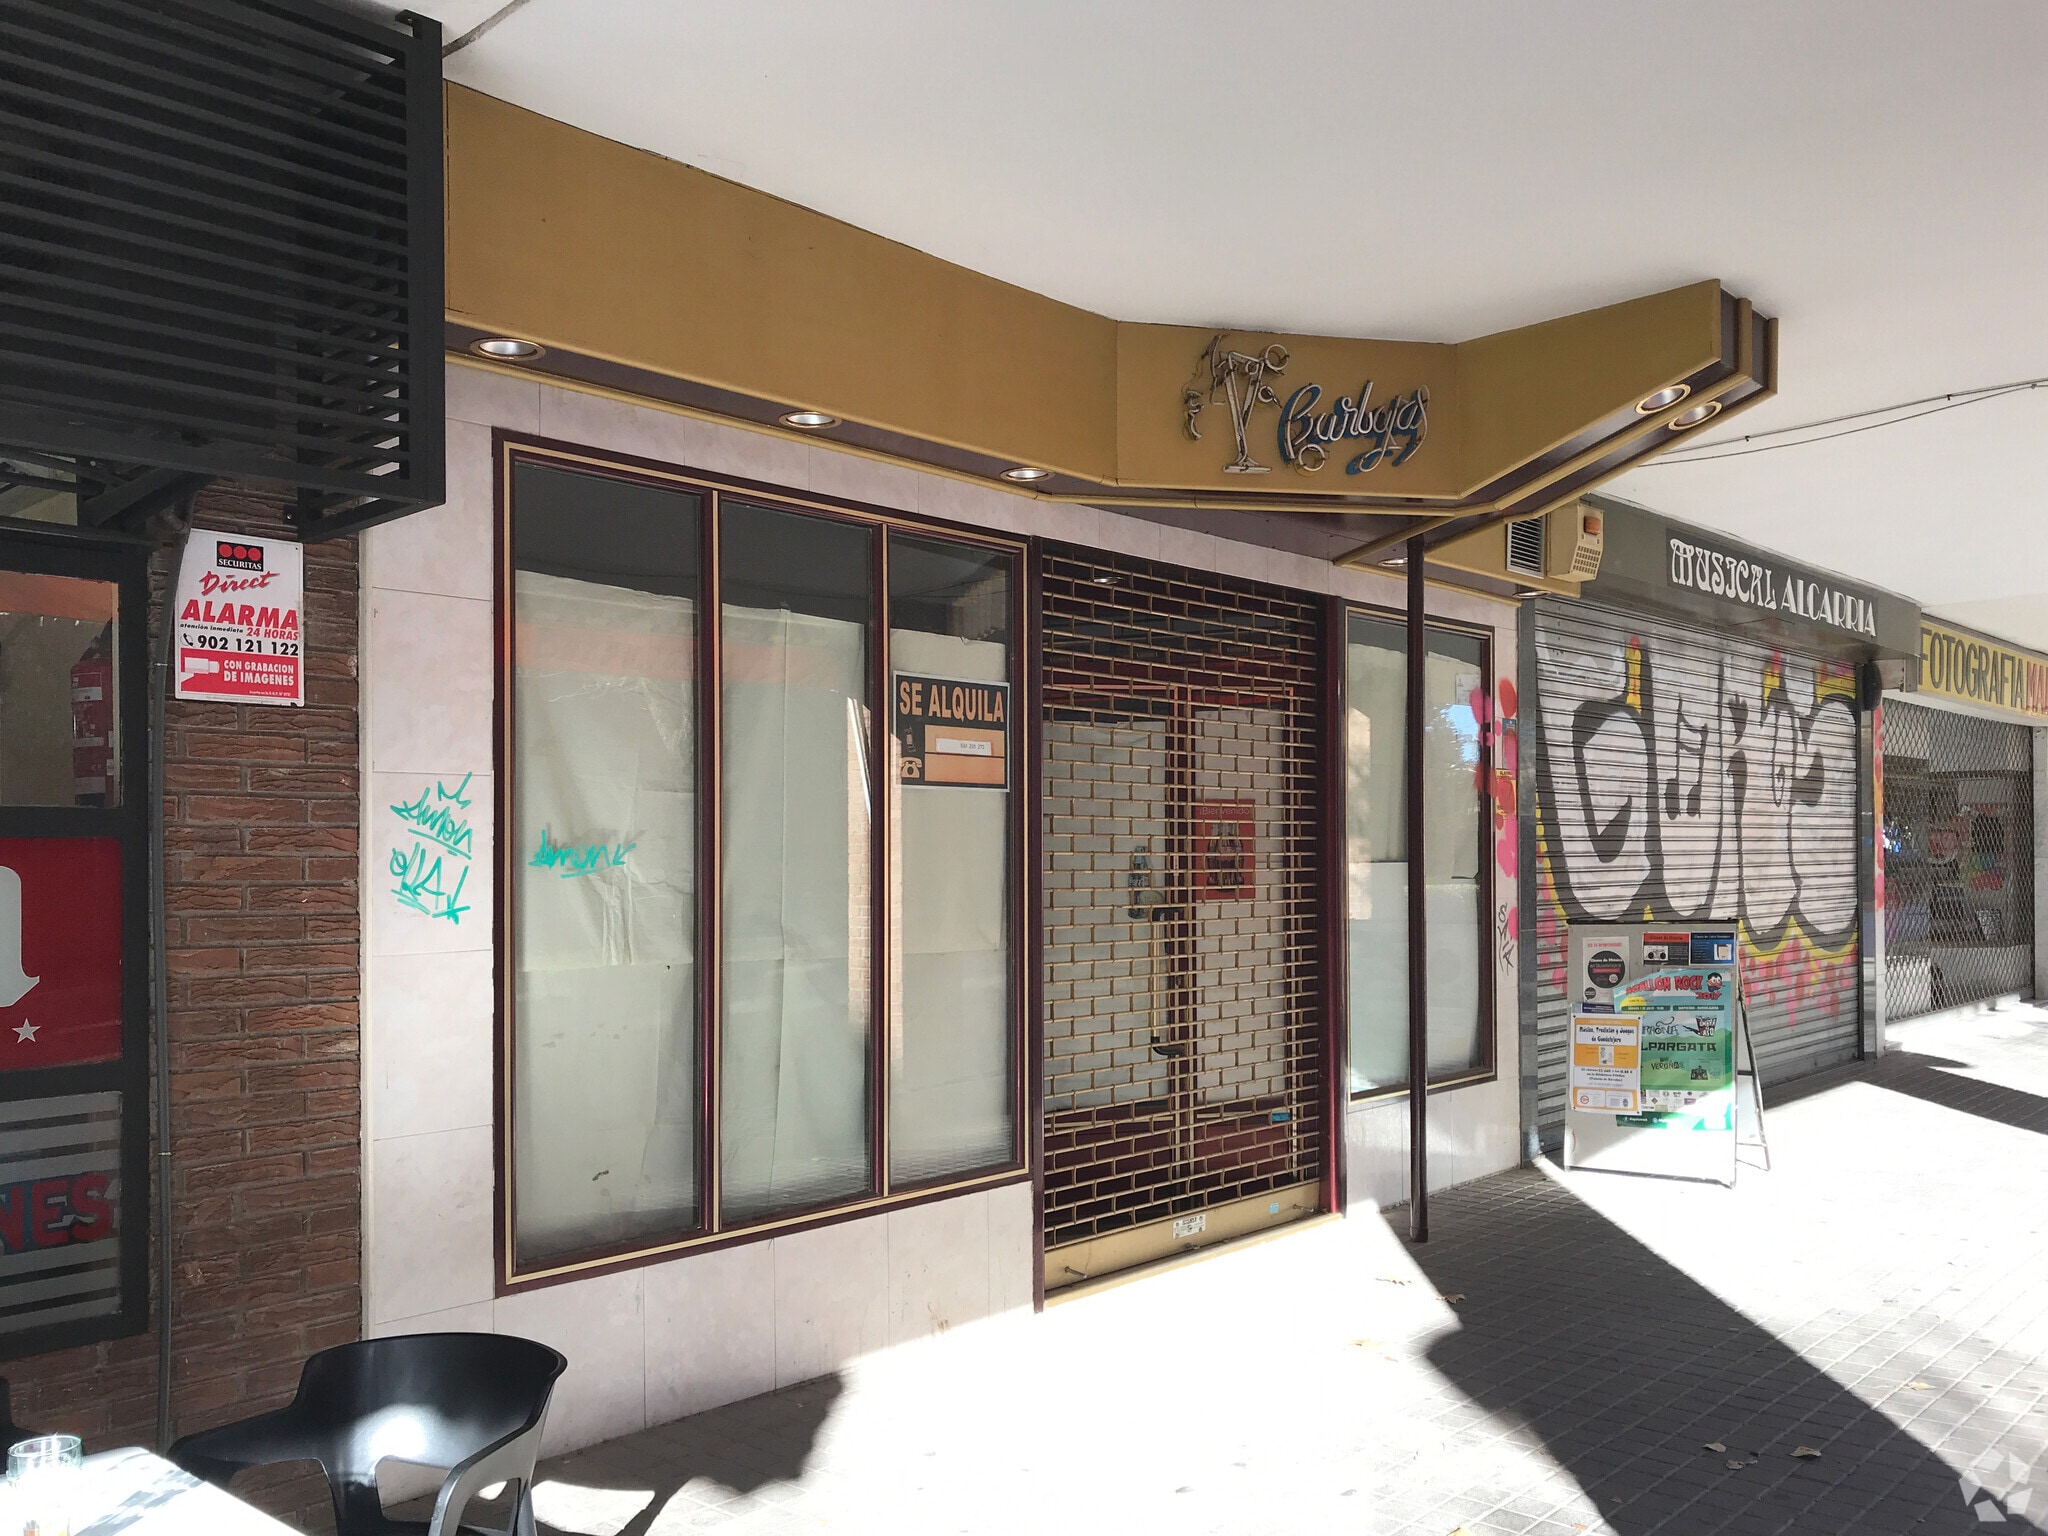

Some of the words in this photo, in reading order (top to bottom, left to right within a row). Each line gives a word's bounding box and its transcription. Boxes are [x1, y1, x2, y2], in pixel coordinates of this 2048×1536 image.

[218, 558, 262, 571] SECURITAS
[199, 571, 280, 596] Direct
[1669, 538, 1777, 611] MUSICAL
[1780, 574, 1877, 637] ALCARRIA
[181, 599, 299, 631] ALARMA
[246, 627, 260, 638] 24
[264, 629, 299, 641] HORAS
[197, 635, 228, 651] 902
[236, 638, 262, 653] 121
[271, 641, 299, 656] 122
[224, 659, 241, 670] CON
[245, 661, 294, 674] GRABACION
[1918, 627, 2025, 710] FOTOGRAFIA
[2026, 660, 2048, 714] MA
[224, 670, 237, 683] DE
[240, 672, 294, 686] IMAGENES
[900, 681, 922, 716] SE
[928, 684, 1004, 722] ALQUILA
[1674, 975, 1703, 991] ROCK
[1641, 1042, 1716, 1052] LPARGATA
